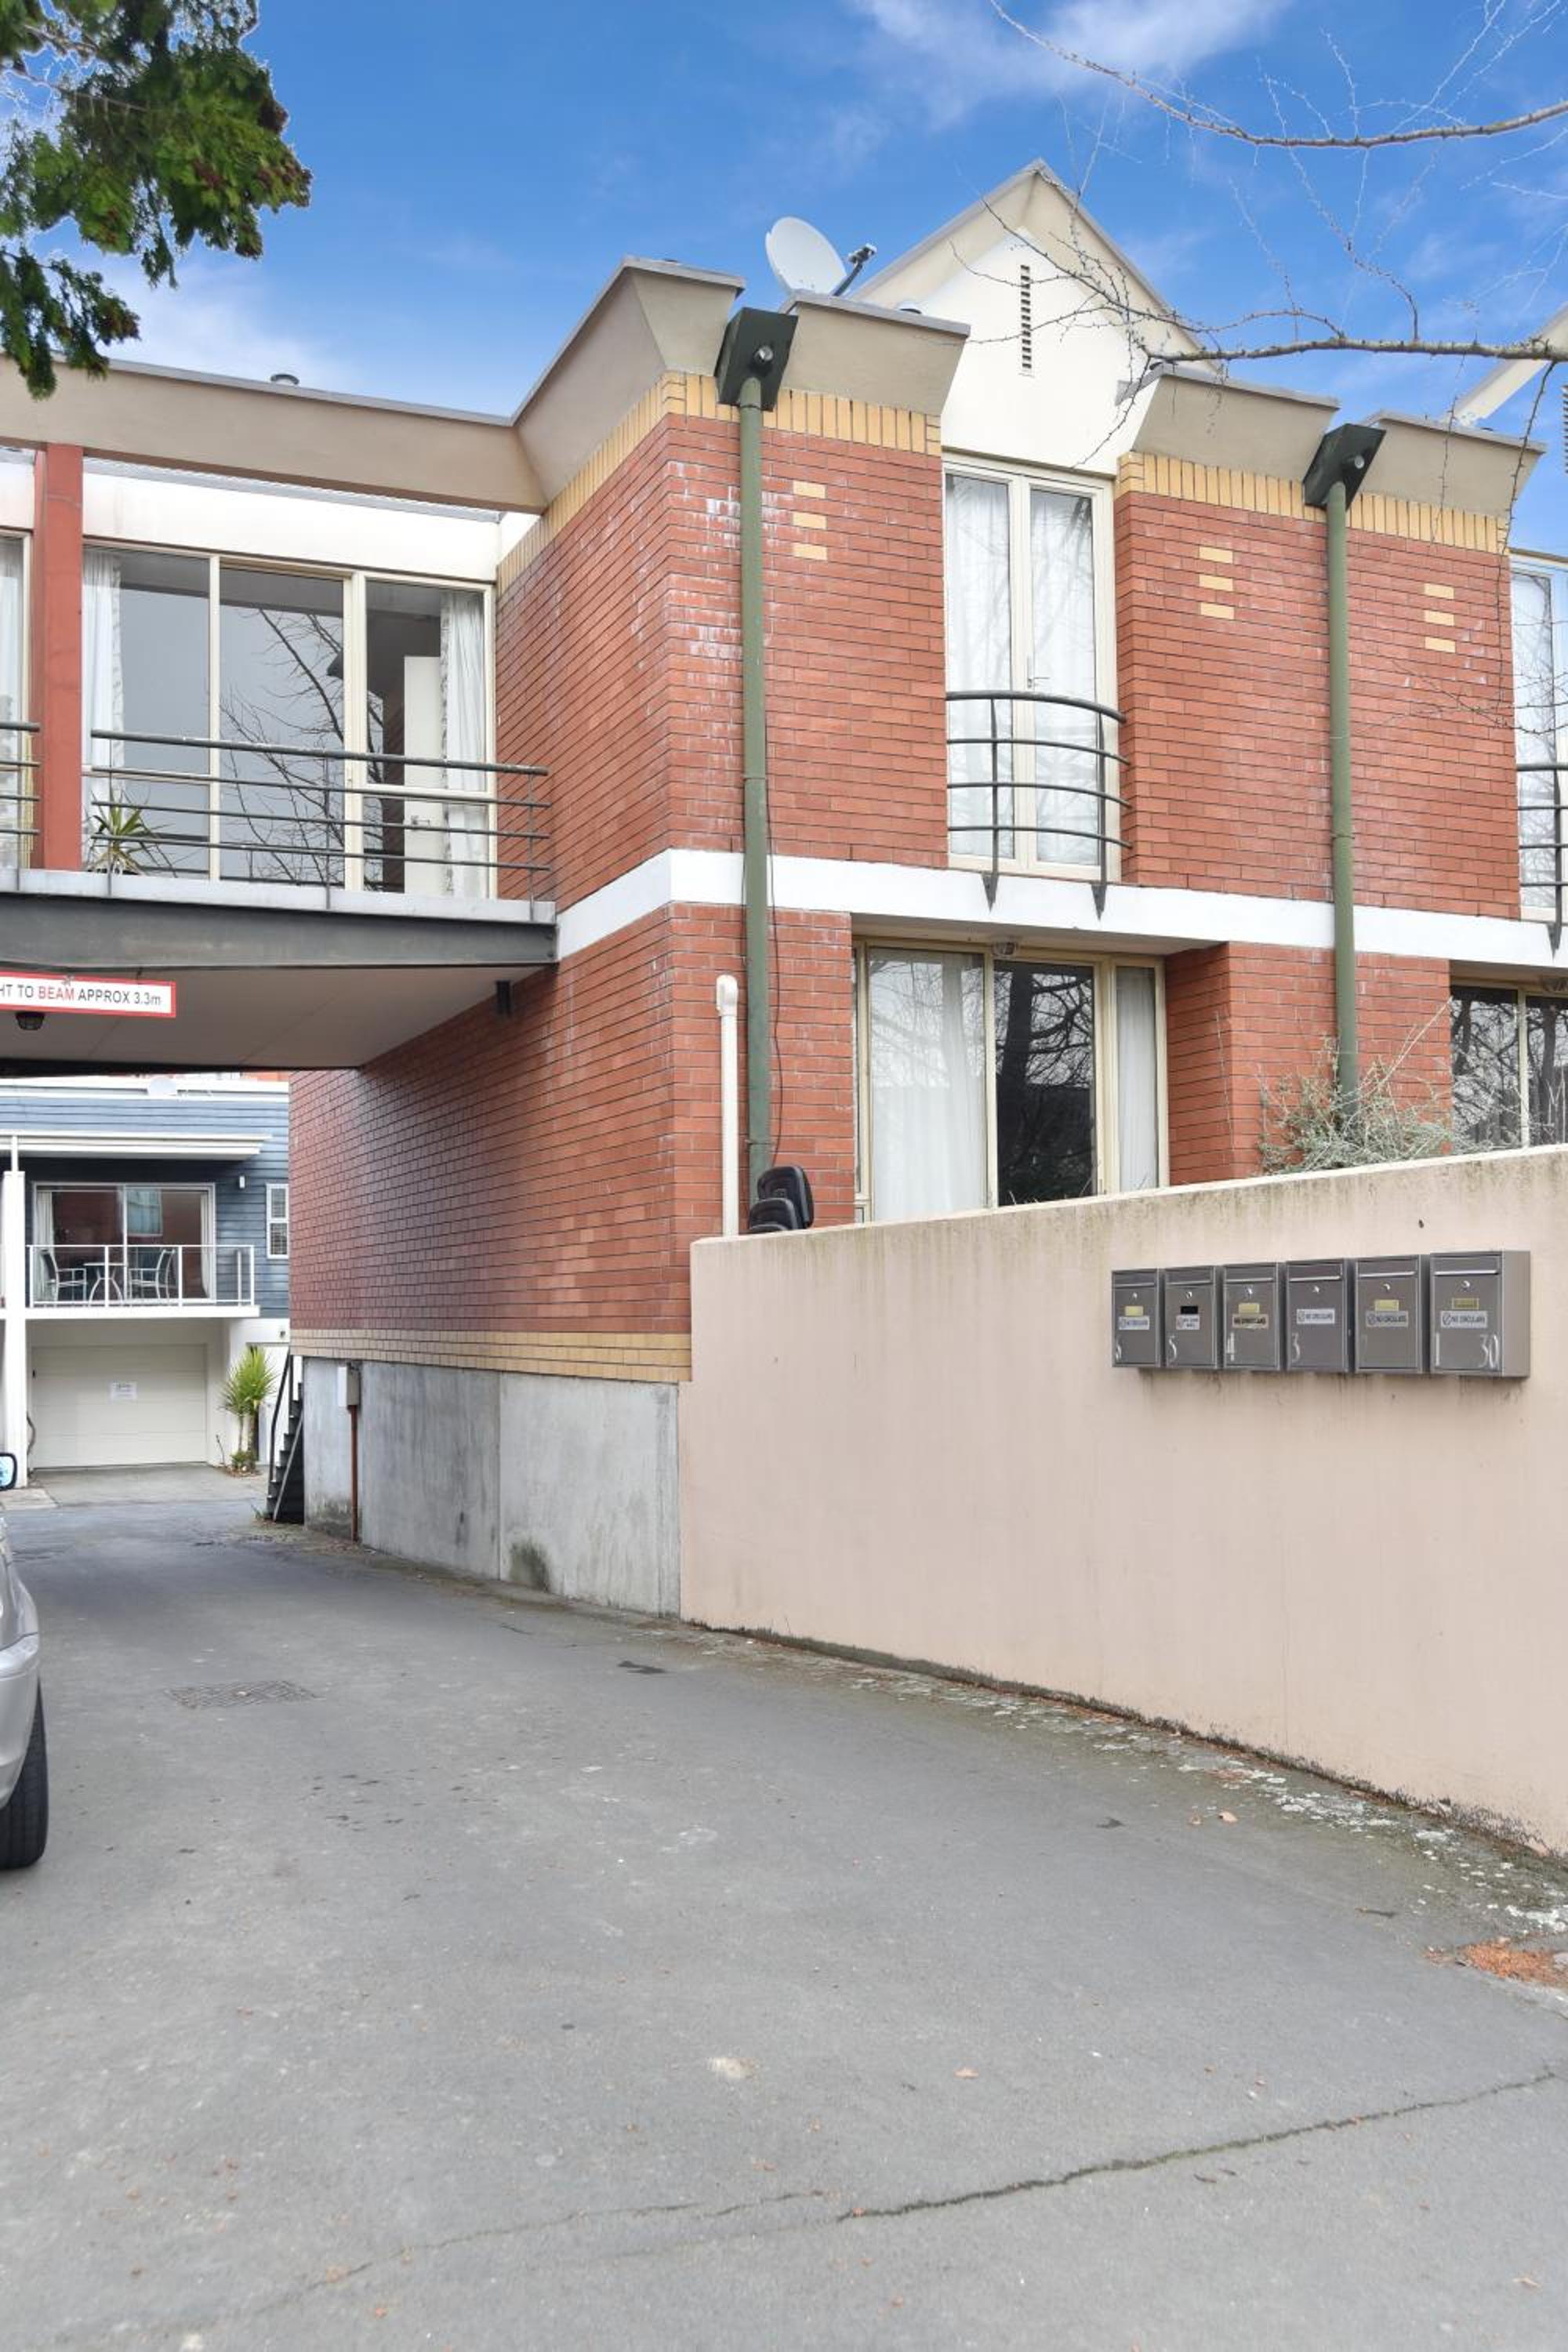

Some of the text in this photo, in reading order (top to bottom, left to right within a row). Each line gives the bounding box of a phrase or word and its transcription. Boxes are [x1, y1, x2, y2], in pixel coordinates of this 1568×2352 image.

[17, 984, 34, 998] TO
[38, 985, 74, 1001] BEAM
[78, 988, 130, 1004] APPROX
[134, 992, 162, 1005] 3.3m
[1479, 1334, 1500, 1368] 30
